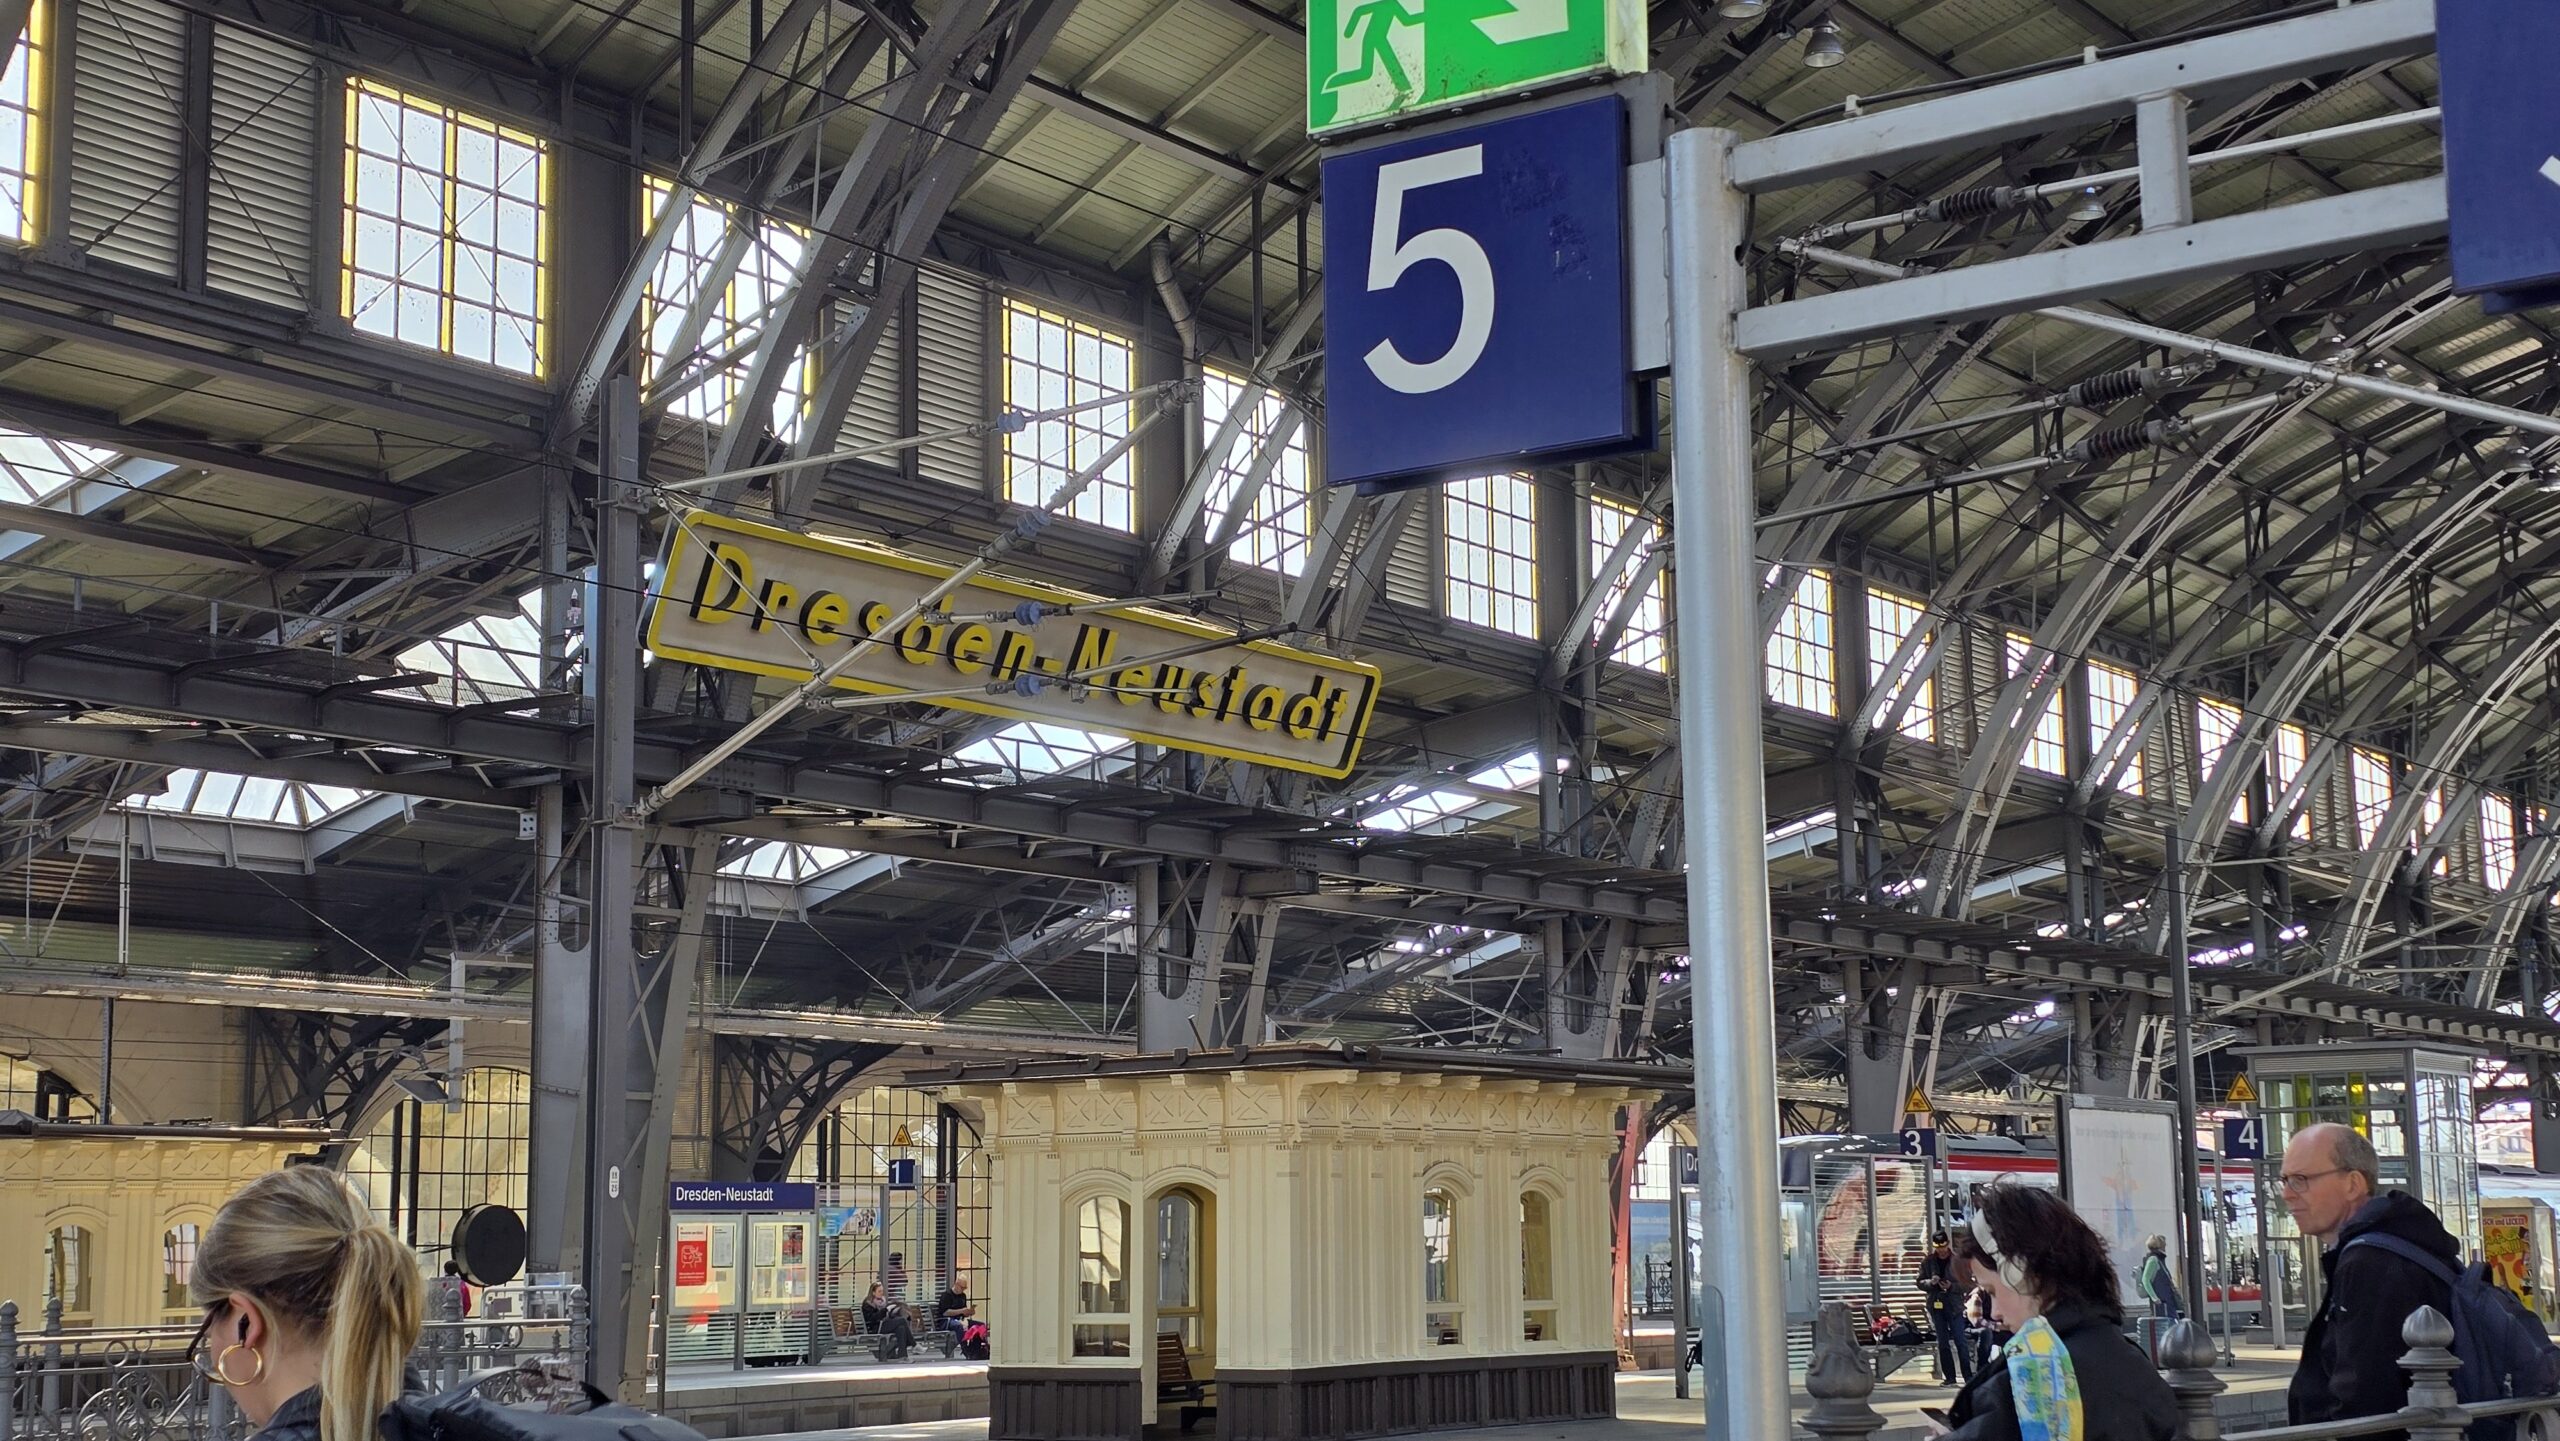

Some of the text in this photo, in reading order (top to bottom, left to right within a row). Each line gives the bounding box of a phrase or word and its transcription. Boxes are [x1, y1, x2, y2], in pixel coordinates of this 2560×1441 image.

[1362, 143, 1496, 394] 5
[689, 540, 1350, 744] Dresden-Neustadt
[1904, 1130, 1923, 1157] 3
[2238, 1119, 2259, 1150] 4
[891, 1160, 900, 1184] 1
[675, 1186, 774, 1202] Dresden-Neustadt
